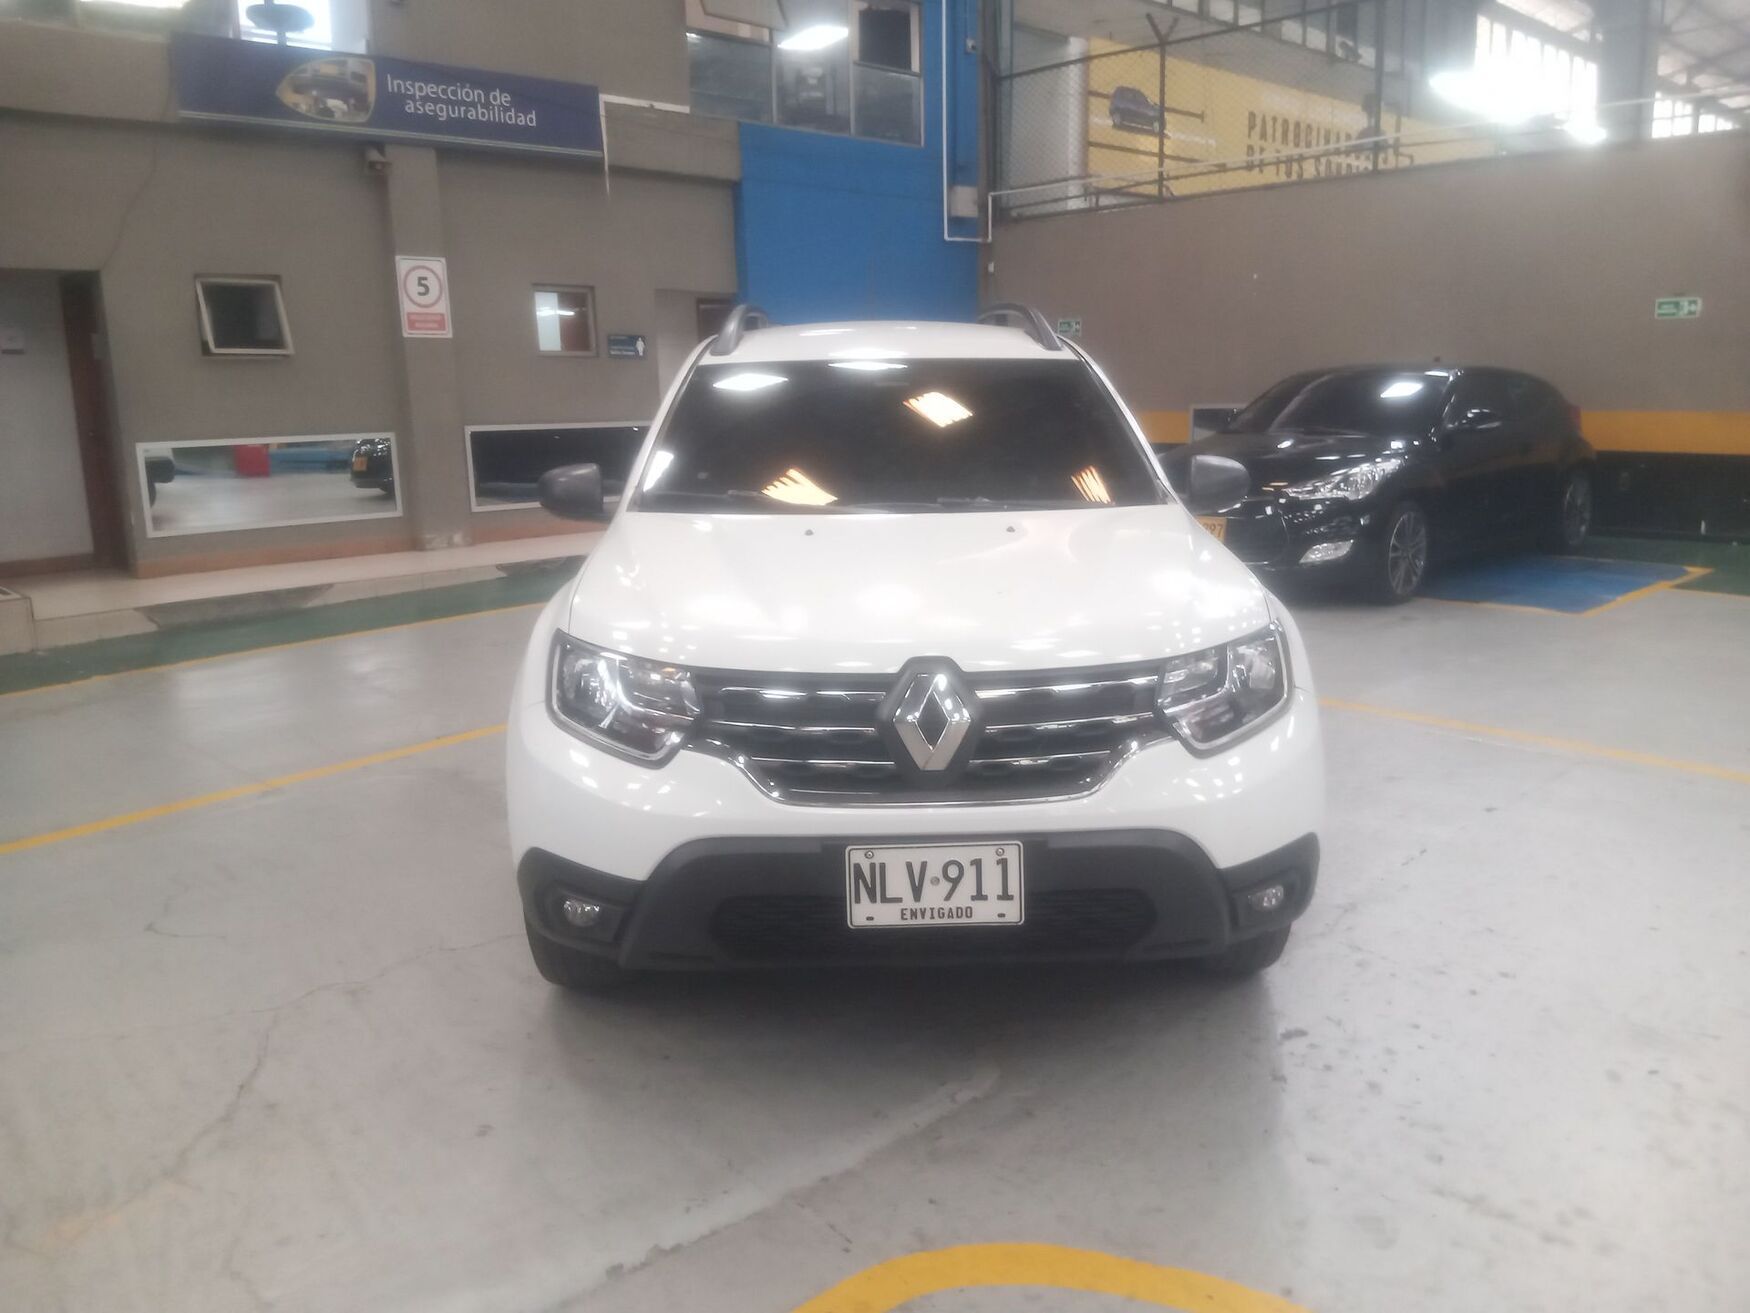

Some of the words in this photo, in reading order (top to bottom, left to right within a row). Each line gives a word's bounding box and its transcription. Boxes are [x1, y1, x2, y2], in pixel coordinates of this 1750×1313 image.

[386, 73, 485, 103] Inspección
[489, 86, 511, 107] de
[404, 99, 537, 127] asegurabilidad
[1247, 110, 1388, 165] PATROCINAD
[416, 276, 430, 297] 5
[900, 906, 973, 921] ENVIGADO
